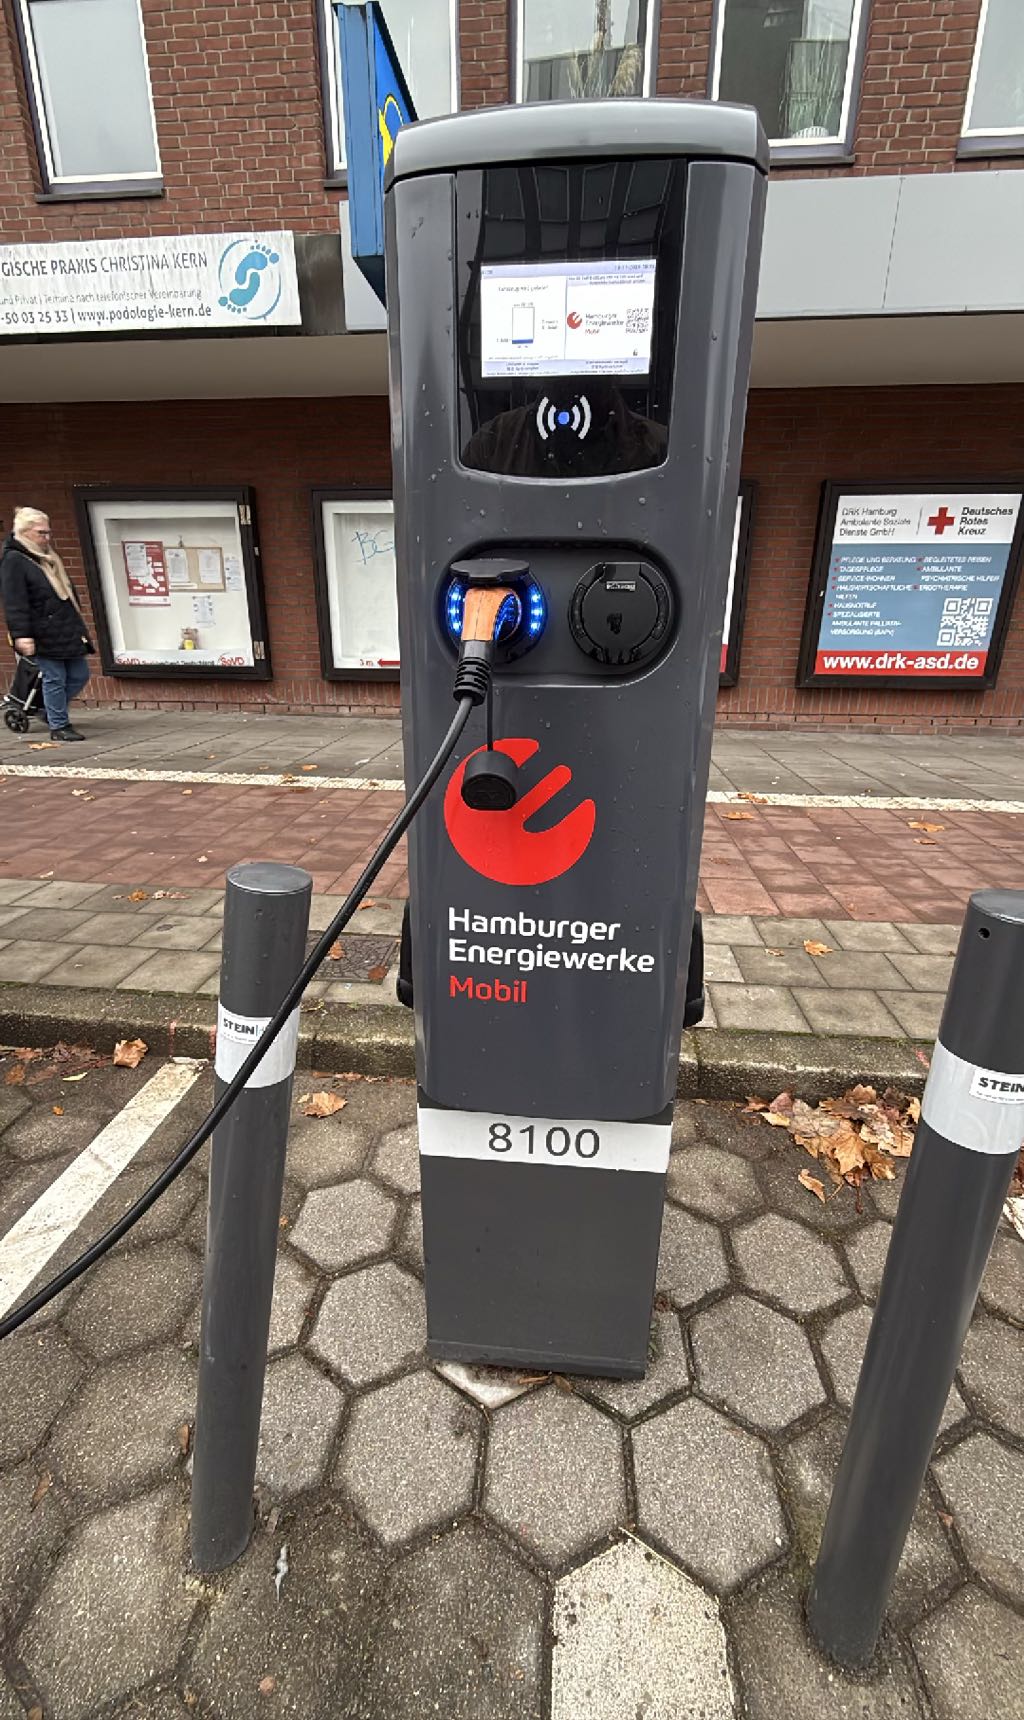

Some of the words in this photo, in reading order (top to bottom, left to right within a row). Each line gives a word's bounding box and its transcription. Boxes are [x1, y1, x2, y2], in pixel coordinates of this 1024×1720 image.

[1, 260, 48, 277] GISCHE
[51, 257, 98, 275] PRAXIS
[100, 254, 170, 273] CHRISTINA
[173, 252, 208, 270] KERN
[21, 311, 35, 324] 03
[38, 310, 52, 323] 25
[55, 310, 69, 323] 33
[78, 303, 212, 325] www.podologie-kern.de
[842, 507, 860, 516] DRK
[861, 507, 897, 518] Hamburg
[961, 506, 1014, 516] Deutsches
[840, 518, 882, 526] Ambulante
[959, 517, 989, 525] Rotes
[839, 528, 868, 536] Dienste
[869, 527, 895, 536] GmbH
[957, 526, 987, 536] Kreuz
[221, 656, 245, 667] SoVD
[823, 652, 979, 671] www.drk-asd.de
[449, 907, 621, 944] Hamburger
[449, 938, 655, 972] Energiewerke
[450, 975, 527, 1003] Mobil
[978, 1077, 1024, 1093] STEIN
[488, 1122, 600, 1158] 8100
